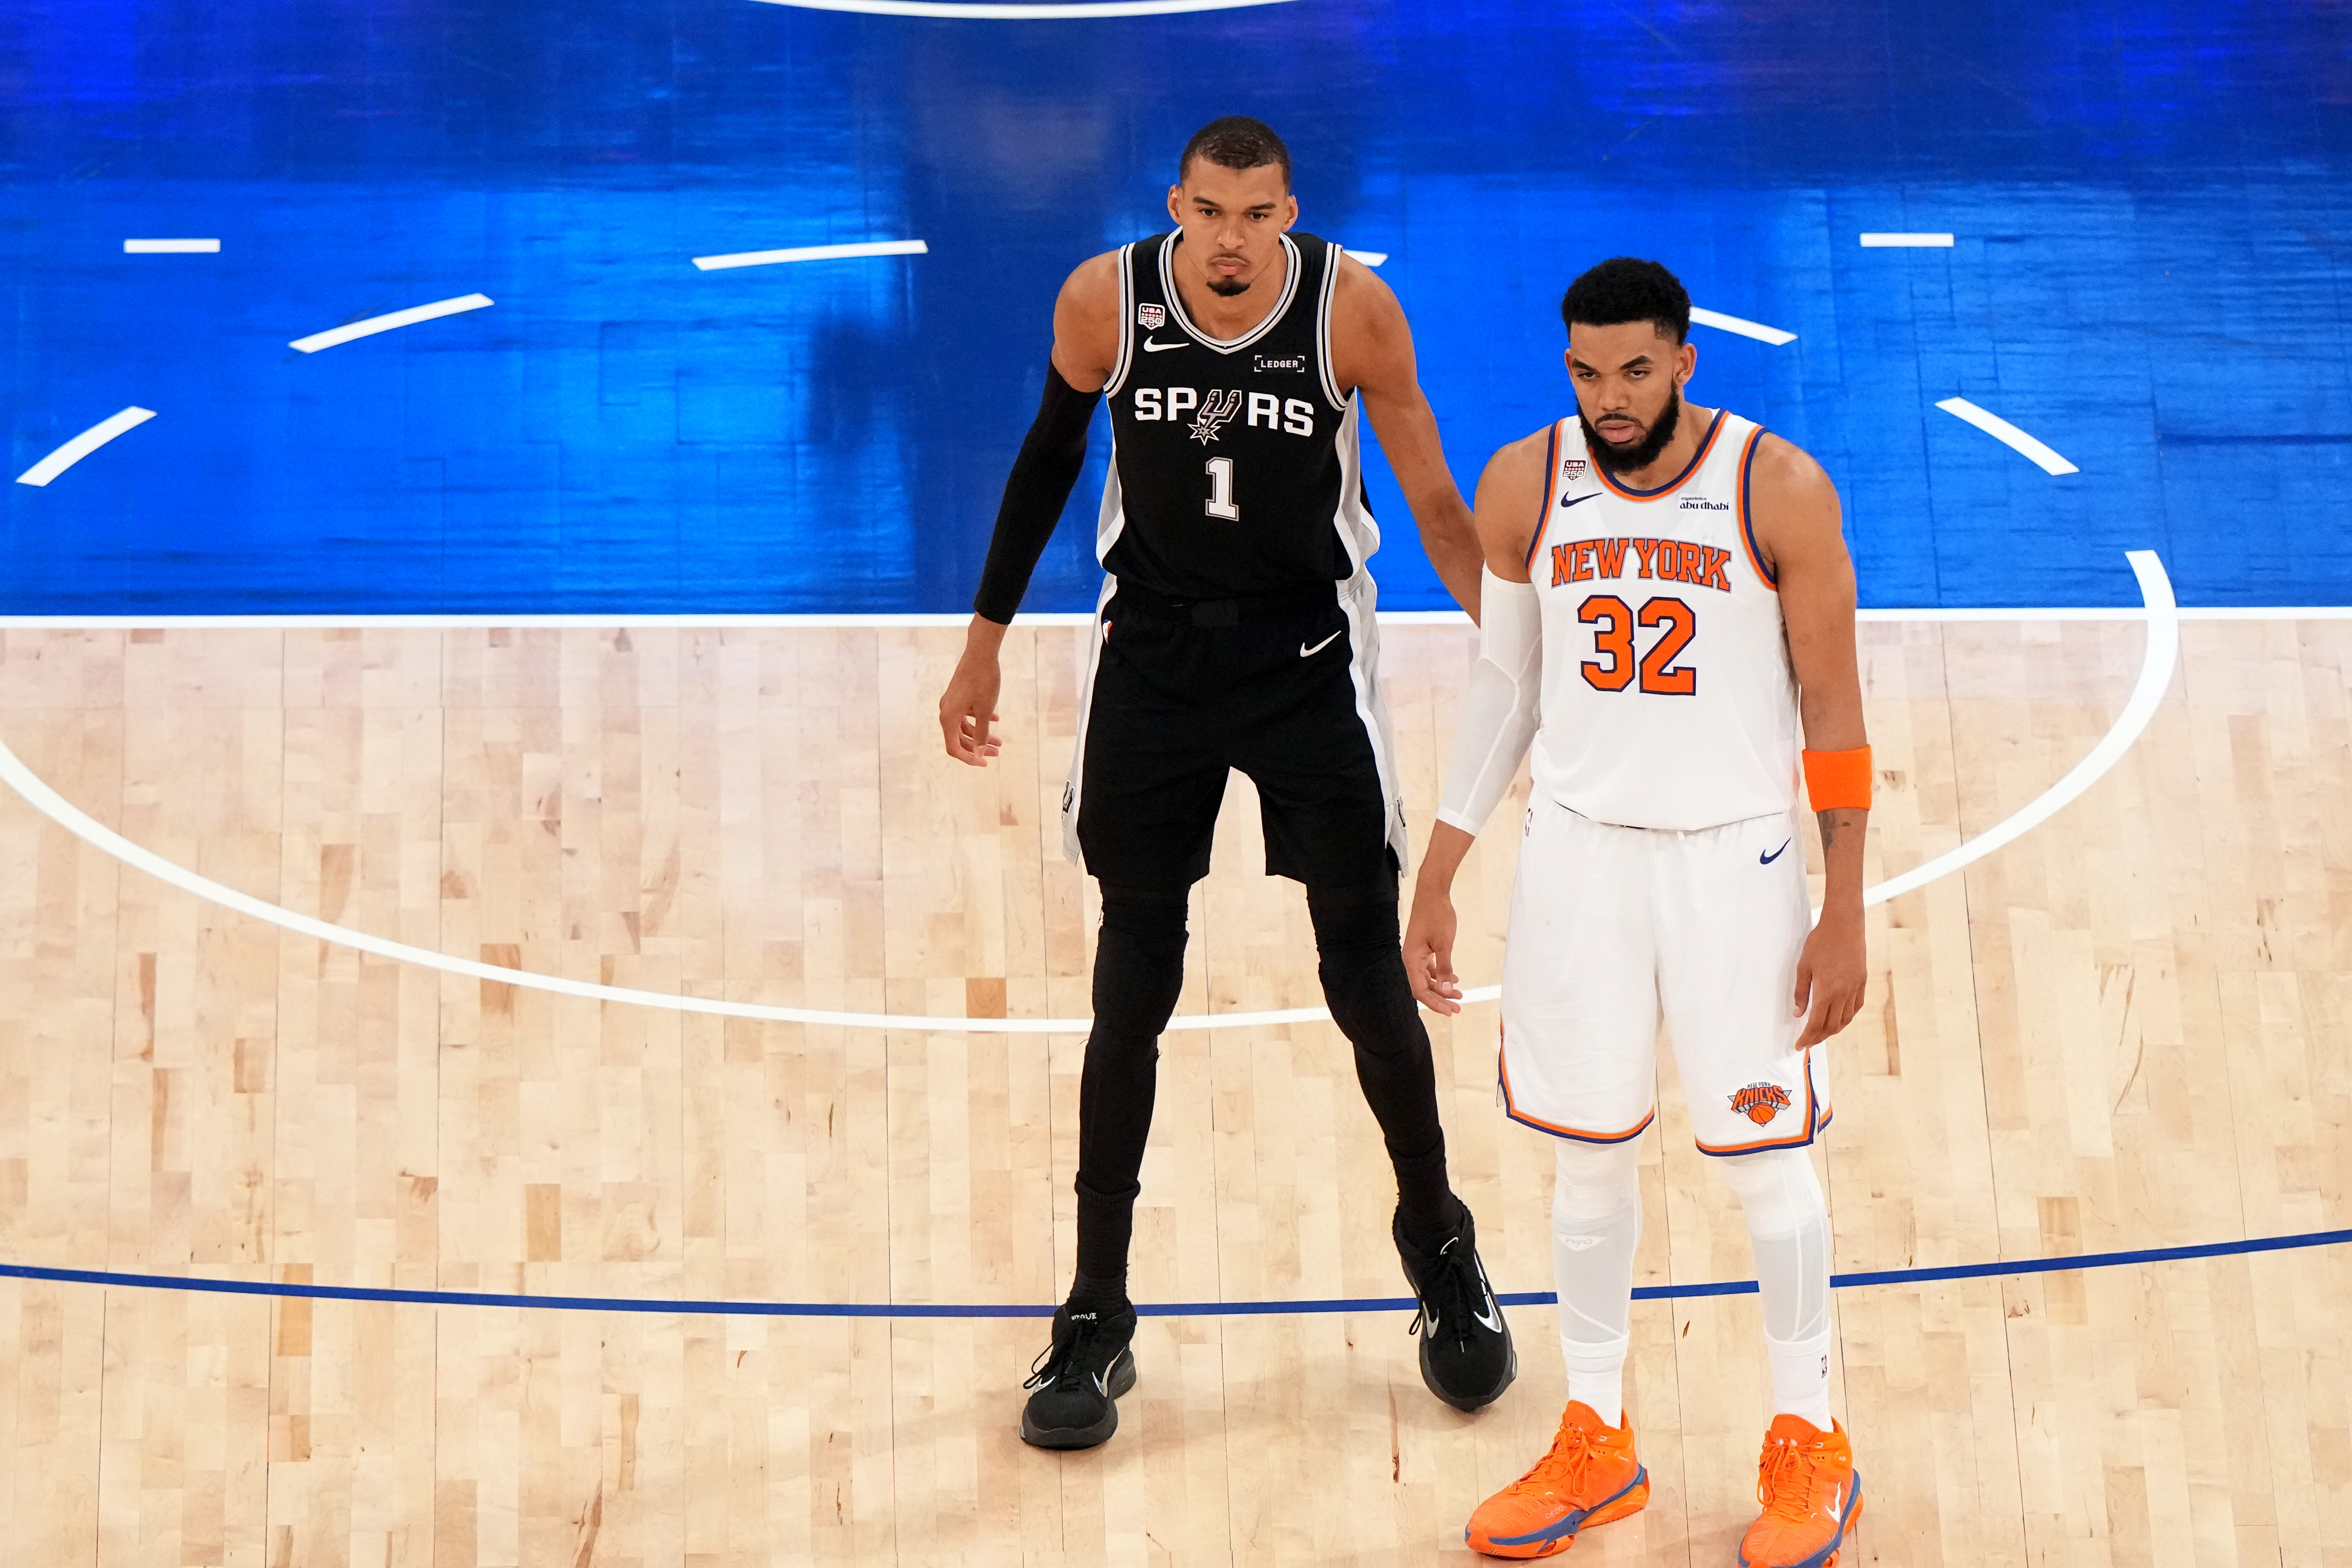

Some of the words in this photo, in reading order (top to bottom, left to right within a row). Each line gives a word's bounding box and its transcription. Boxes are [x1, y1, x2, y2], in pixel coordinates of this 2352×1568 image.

[1205, 457, 1239, 521] 1
[1700, 502, 1729, 510] dhabi
[1551, 537, 1630, 588] NEW
[1633, 537, 1732, 593] YORK
[1577, 595, 1696, 696] 32
[1731, 1085, 1791, 1112] KNICKS
